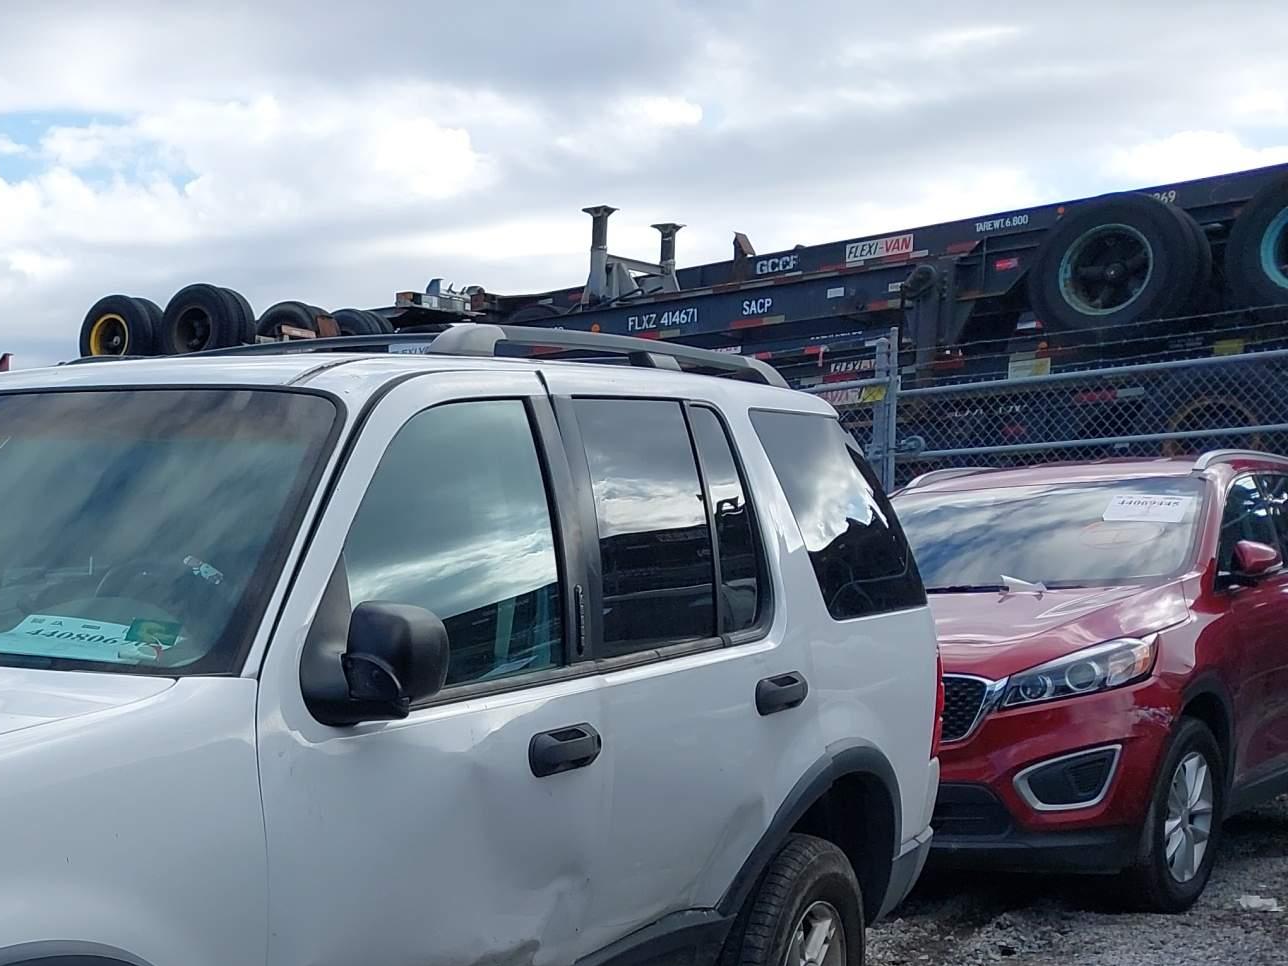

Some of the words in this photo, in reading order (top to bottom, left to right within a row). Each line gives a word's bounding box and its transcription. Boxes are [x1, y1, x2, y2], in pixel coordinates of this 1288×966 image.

[847, 236, 912, 260] FLEXI-VAN
[742, 298, 772, 316] SACP
[627, 313, 657, 331] FLXZ
[660, 308, 698, 326] 414671
